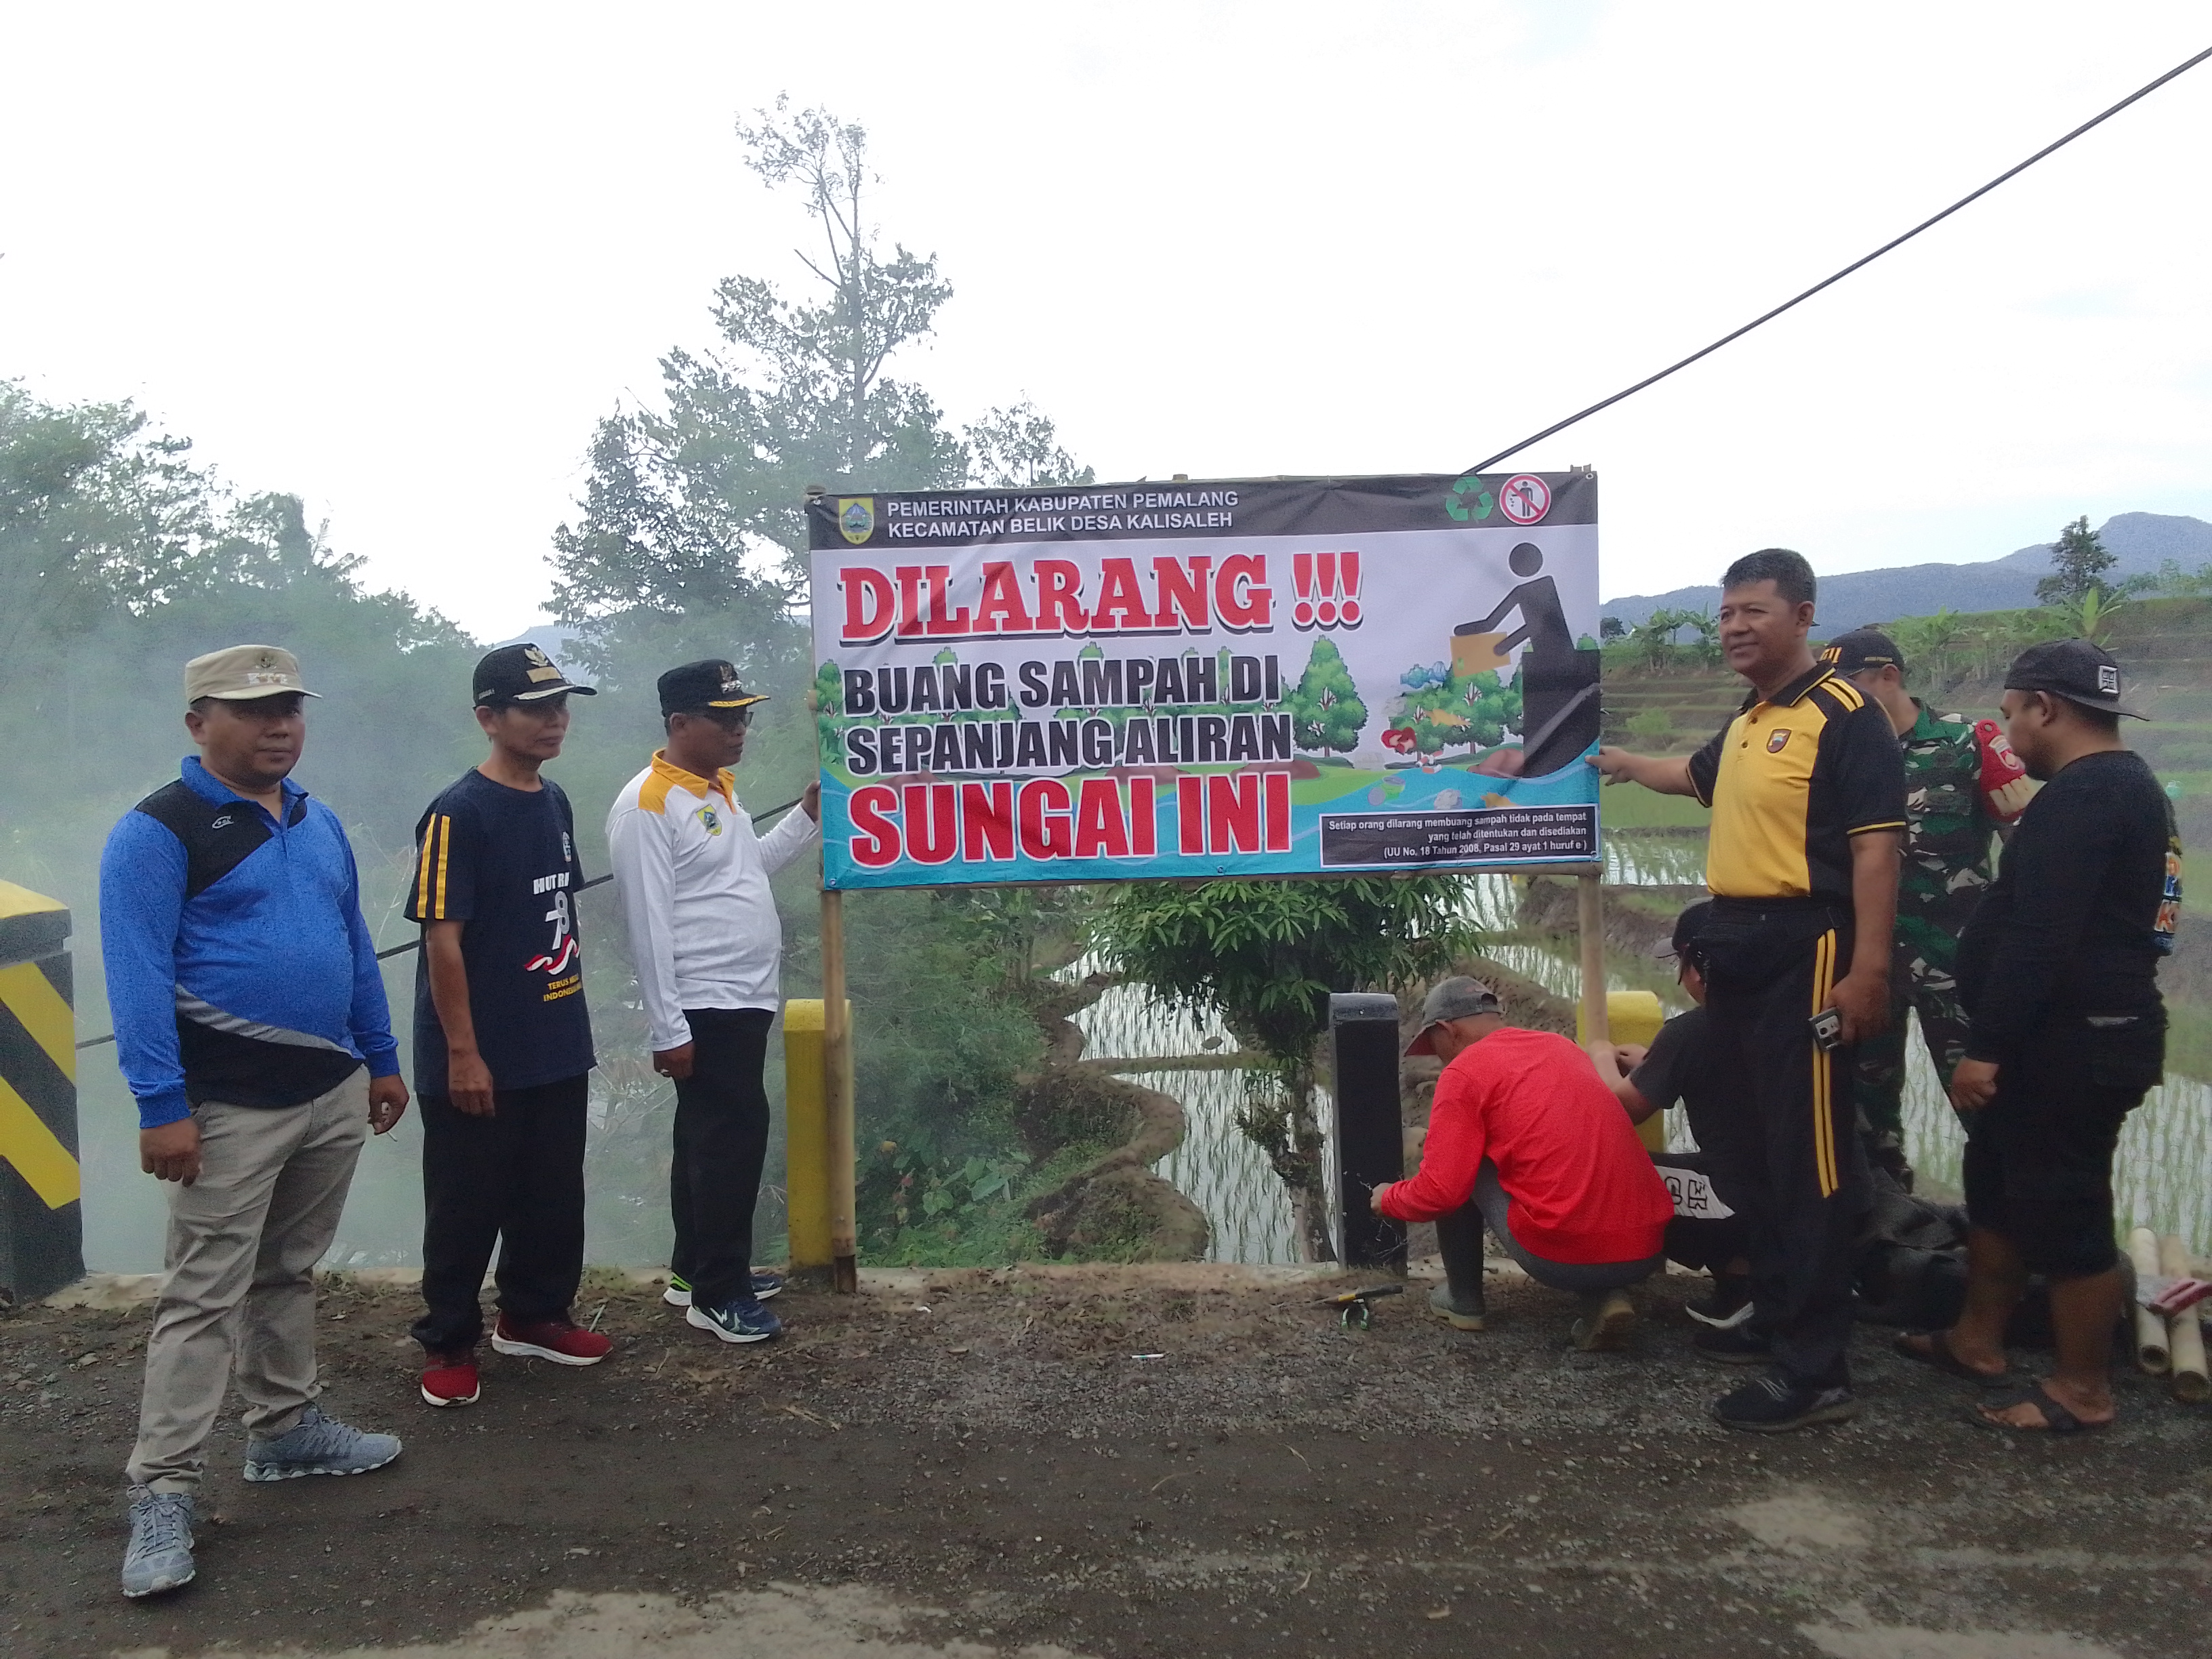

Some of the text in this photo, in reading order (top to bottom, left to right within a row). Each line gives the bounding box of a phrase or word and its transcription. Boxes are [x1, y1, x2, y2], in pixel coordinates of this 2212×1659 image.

[887, 491, 1240, 518] PEMERINTAH KABUPATEN PEMALANG
[888, 511, 1233, 539] KECAMATAN BELIK DESA KALISALEH
[838, 551, 1364, 646] DILARANG !!!
[844, 654, 1282, 717] BUANG SAMPAH DI
[846, 713, 1294, 777] SEPANJANG ALIRAN
[848, 771, 1292, 869] SUNGAI INI
[1328, 812, 1586, 832] Setiap orang dilarang membuang sampah tidak pada tempat
[1428, 826, 1586, 843] yang telah ditentukan dan disediakan
[1384, 847, 1400, 859] (UU
[1403, 847, 1418, 857] No.
[1420, 846, 1430, 856] 18
[1432, 846, 1458, 855] Tahun
[1483, 842, 1508, 853] Pasal
[1509, 842, 1520, 851] 29
[1521, 841, 1541, 853] ayat
[1543, 841, 1547, 851] 1
[533, 872, 570, 895] HUT RI
[548, 977, 569, 990] TERUS
